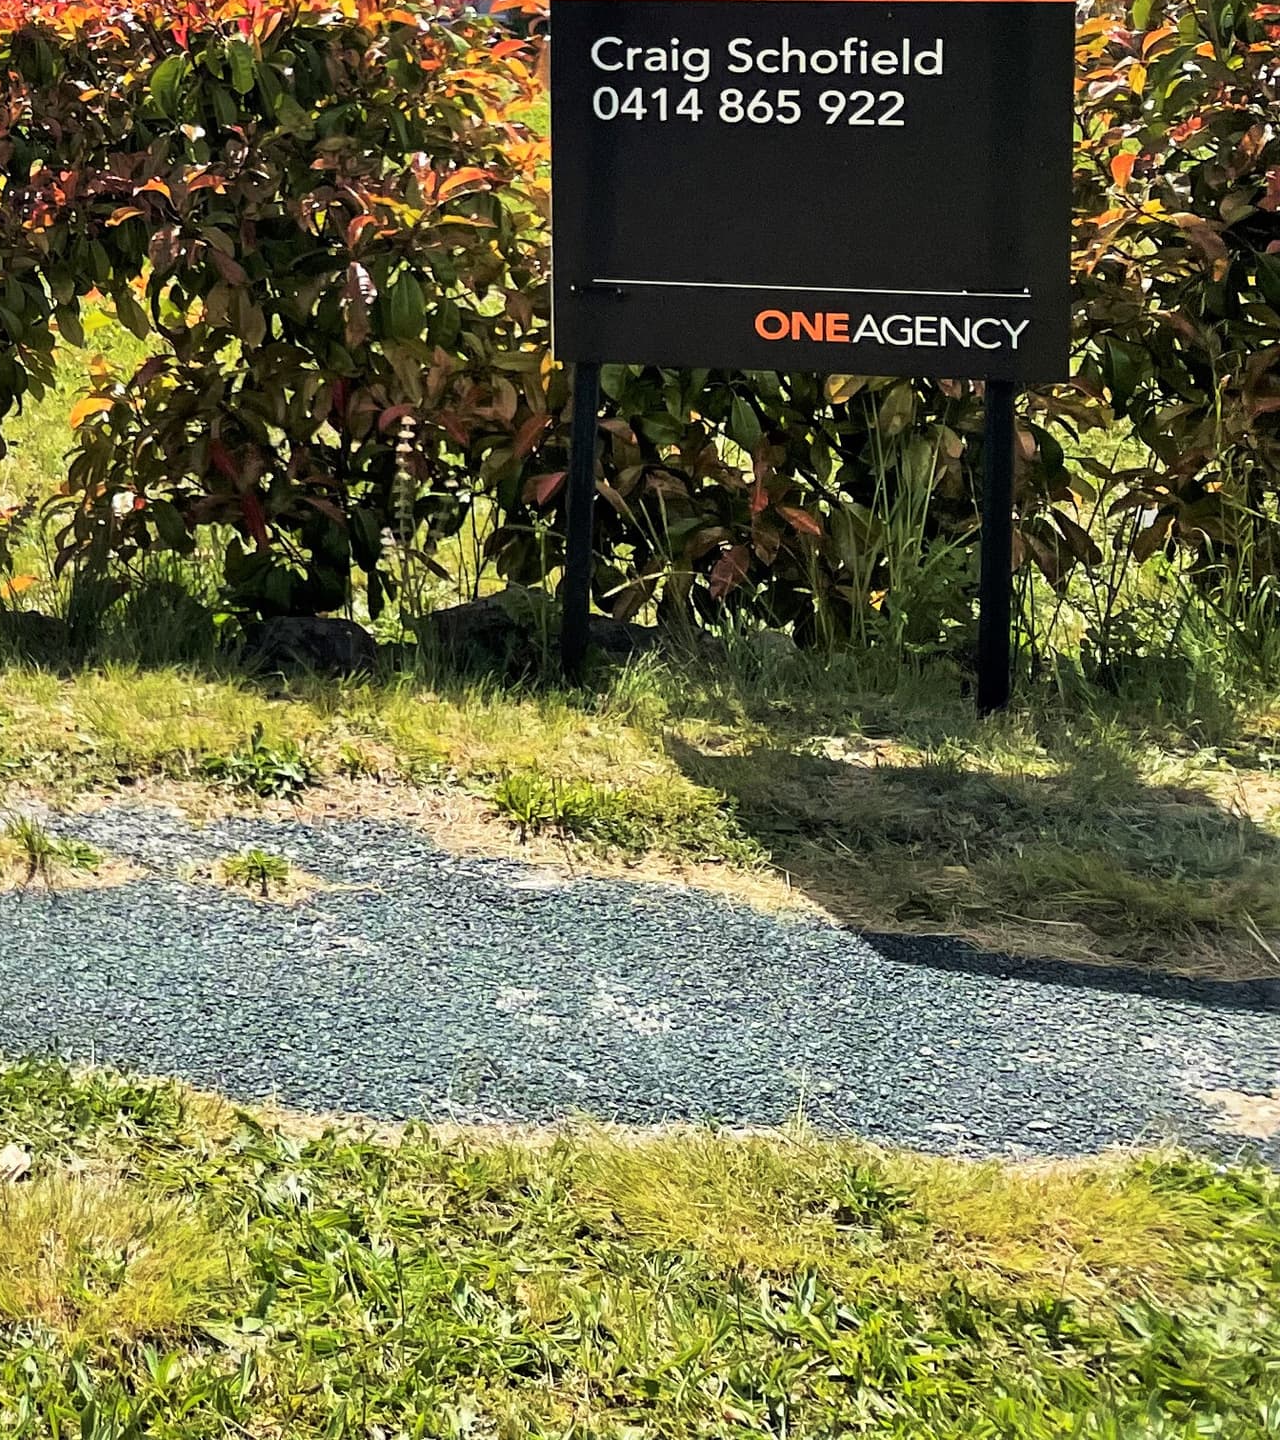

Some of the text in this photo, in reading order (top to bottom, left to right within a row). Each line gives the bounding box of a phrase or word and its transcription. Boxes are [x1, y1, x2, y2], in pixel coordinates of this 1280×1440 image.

[591, 36, 943, 83] Craig Schofield
[592, 87, 905, 126] 0414 865 922
